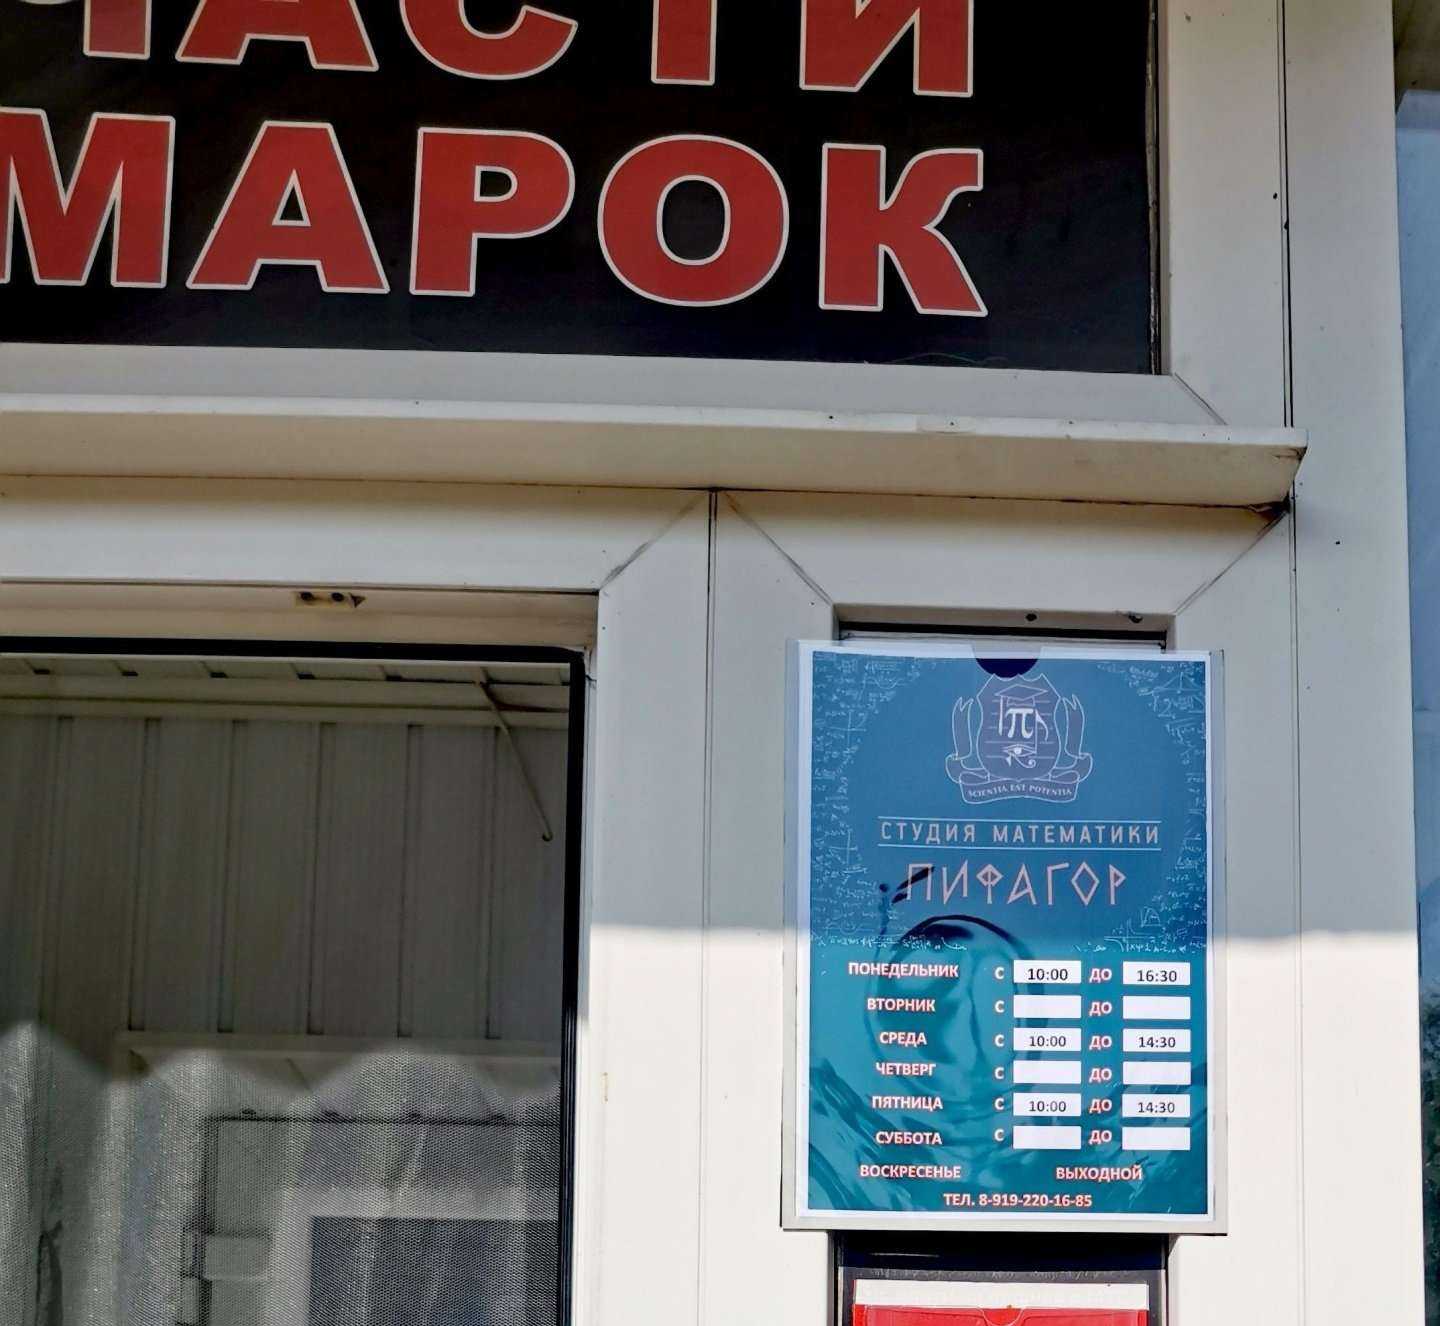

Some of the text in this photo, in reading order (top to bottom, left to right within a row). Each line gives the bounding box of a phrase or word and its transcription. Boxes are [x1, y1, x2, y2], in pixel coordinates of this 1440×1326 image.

[0, 108, 988, 317] МАРОК
[881, 821, 1160, 845] СТУДИЯ МАТЕМАТИКИ
[906, 859, 1127, 907] ПИФАГОР
[848, 962, 1178, 983] ПОНЕДЕЛЬНИК С 10:00 ДО 16:30
[867, 998, 1112, 1016] ВТОРНИК С ДО
[879, 1031, 1176, 1050] СРЕДА С 10:00 ДО 14:30
[876, 1062, 1112, 1083] ЧЕТВЕРГ С ДО
[872, 1096, 1175, 1114] ПЯТНИЦА С 10:00 ДО 14:30
[876, 1128, 1112, 1146] СУББОТА С ДО
[860, 1163, 1142, 1182] ВОСКРЕСЕНЬЕ ВЫХОДНОЙ
[943, 1193, 1092, 1208] ТЕЛ. 8-919-220-16-85
